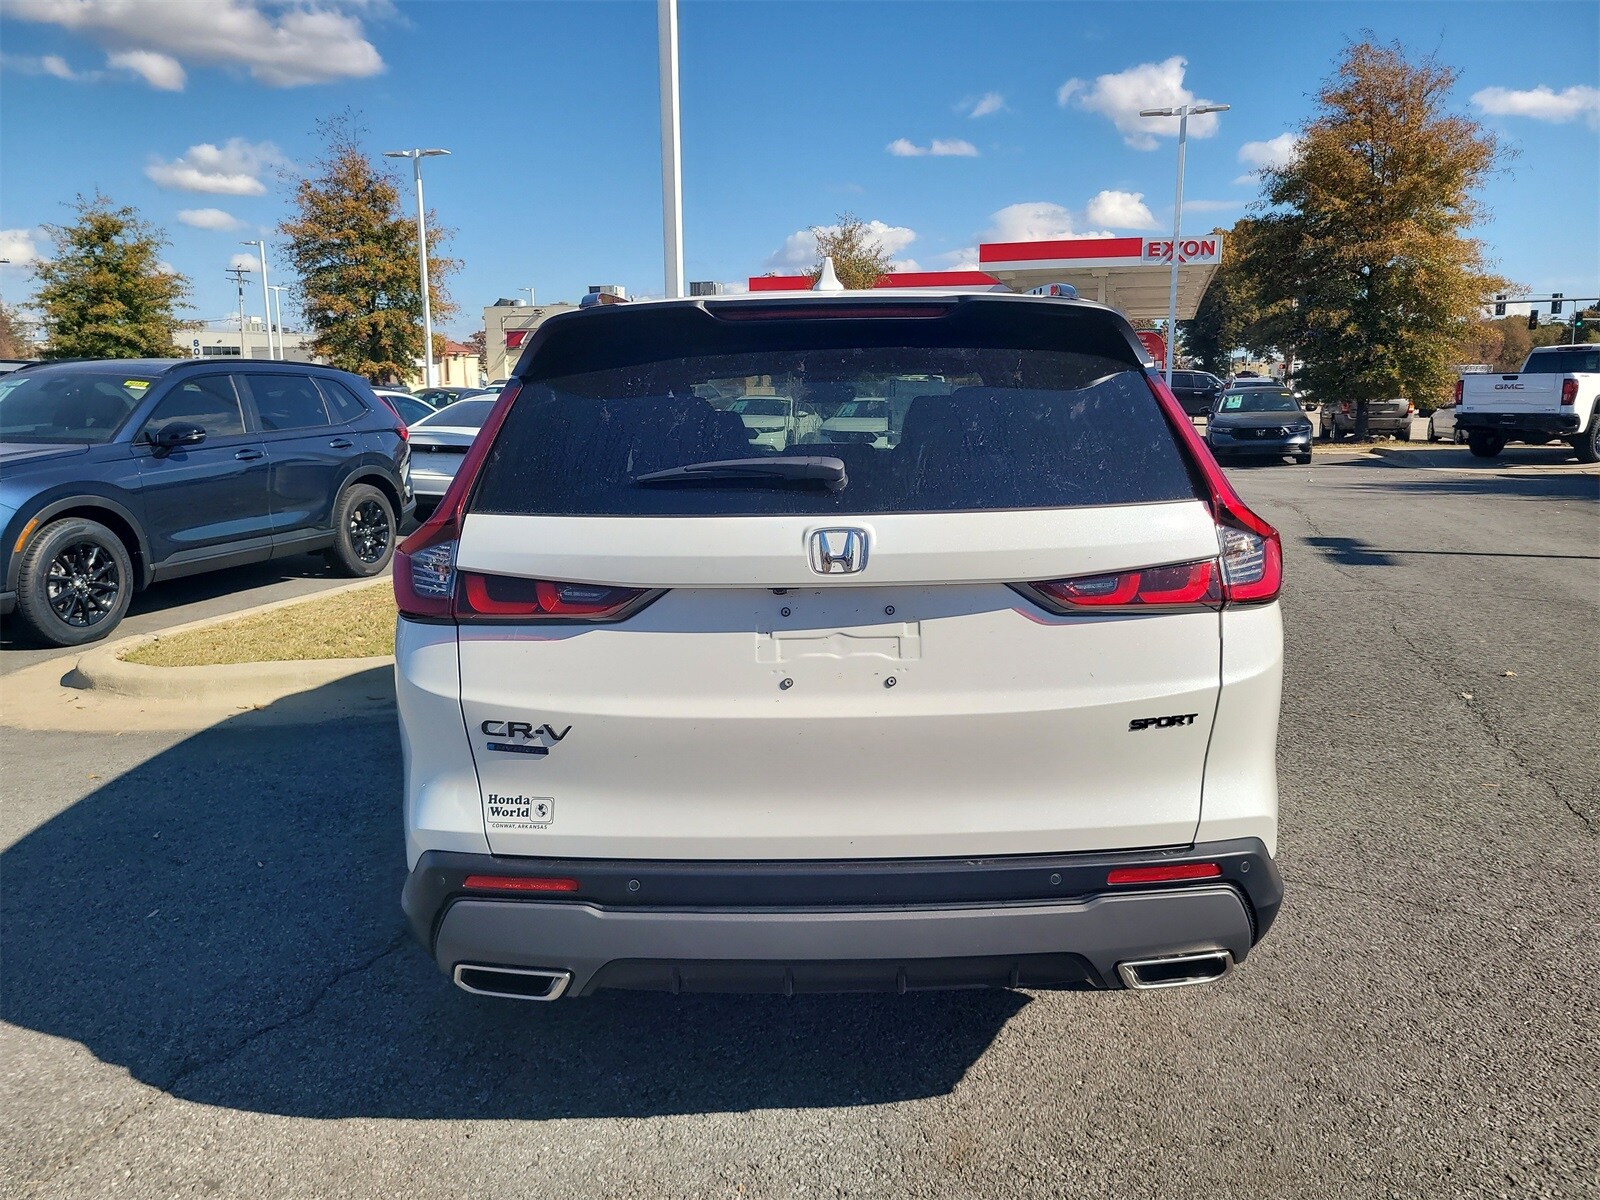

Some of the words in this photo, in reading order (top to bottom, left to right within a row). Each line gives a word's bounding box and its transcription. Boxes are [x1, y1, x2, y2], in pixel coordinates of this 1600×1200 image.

[1128, 713, 1199, 731] SPORT
[481, 719, 573, 741] CR-V
[487, 794, 531, 805] Honda
[489, 806, 530, 818] World
